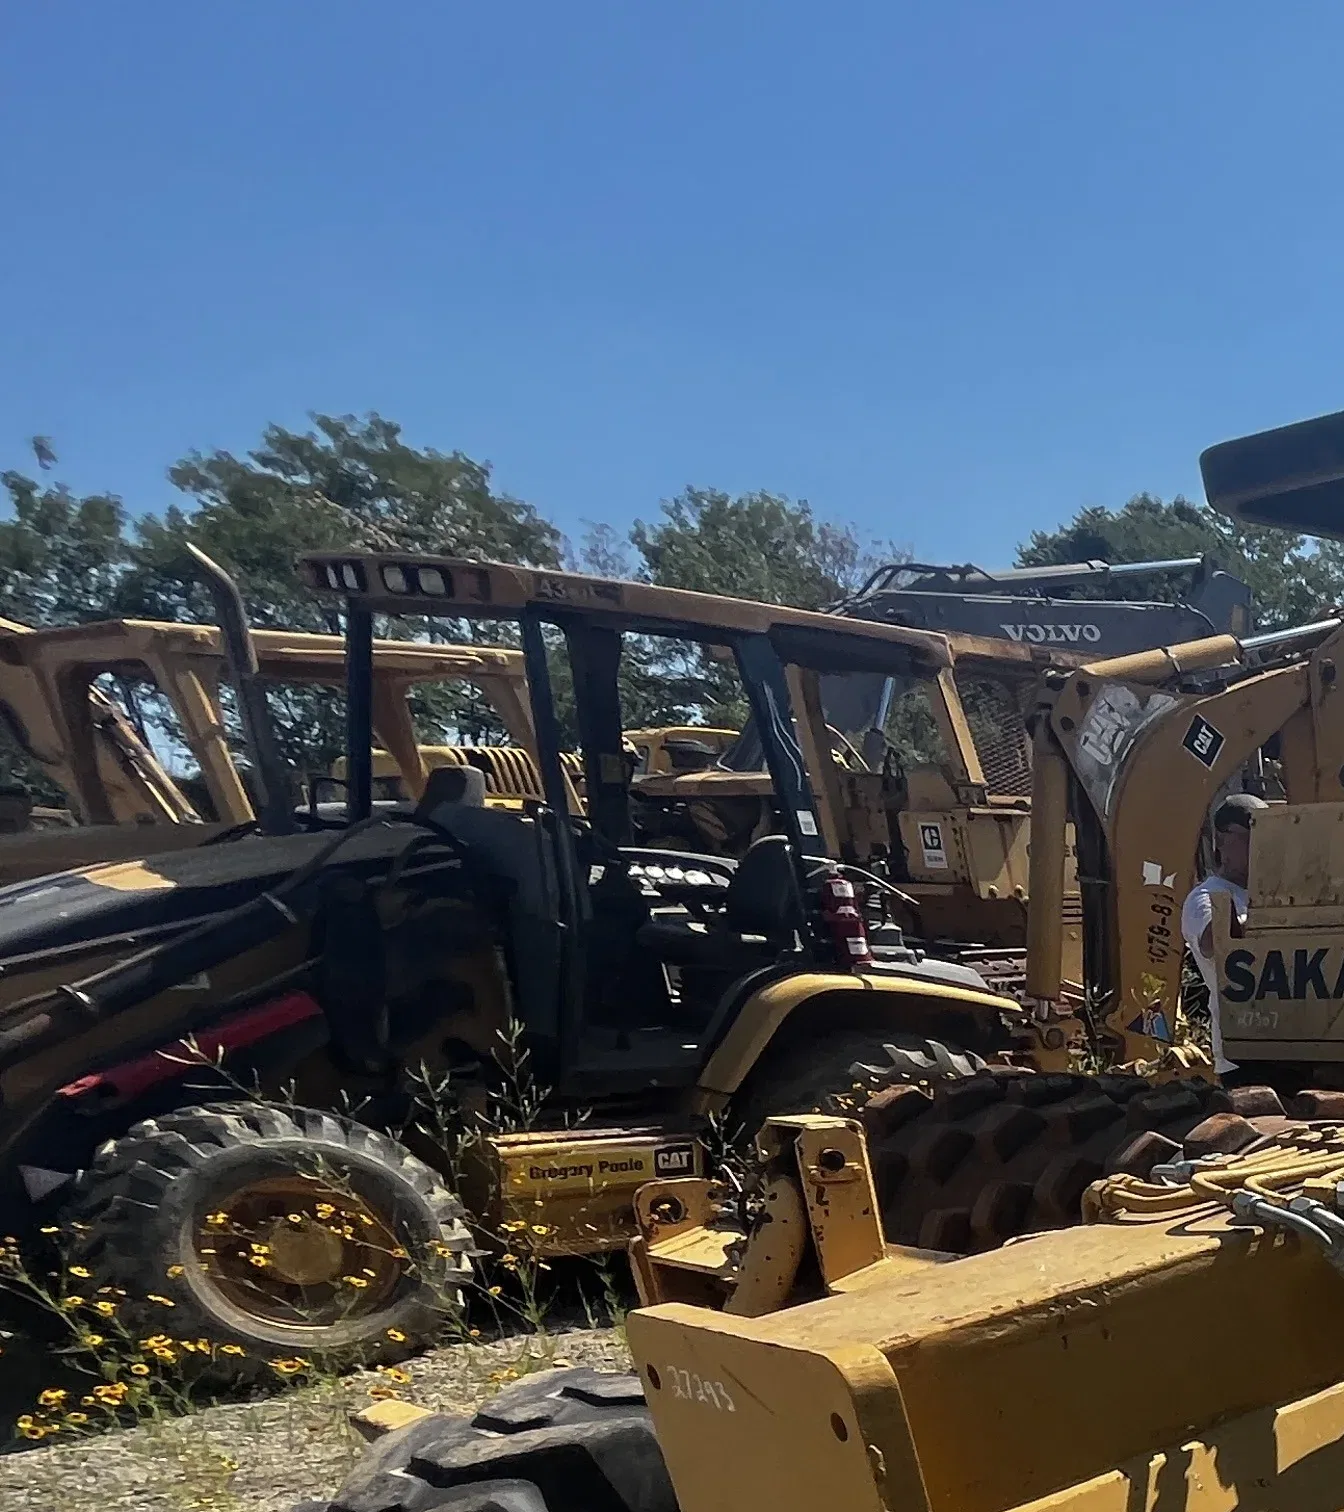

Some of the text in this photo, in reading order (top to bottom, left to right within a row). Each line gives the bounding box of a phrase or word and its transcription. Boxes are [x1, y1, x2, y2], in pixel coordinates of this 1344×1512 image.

[1000, 624, 1102, 642] VOLVO
[1193, 725, 1214, 755] CAT
[598, 1158, 644, 1174] Poole
[657, 1151, 689, 1169] CAT
